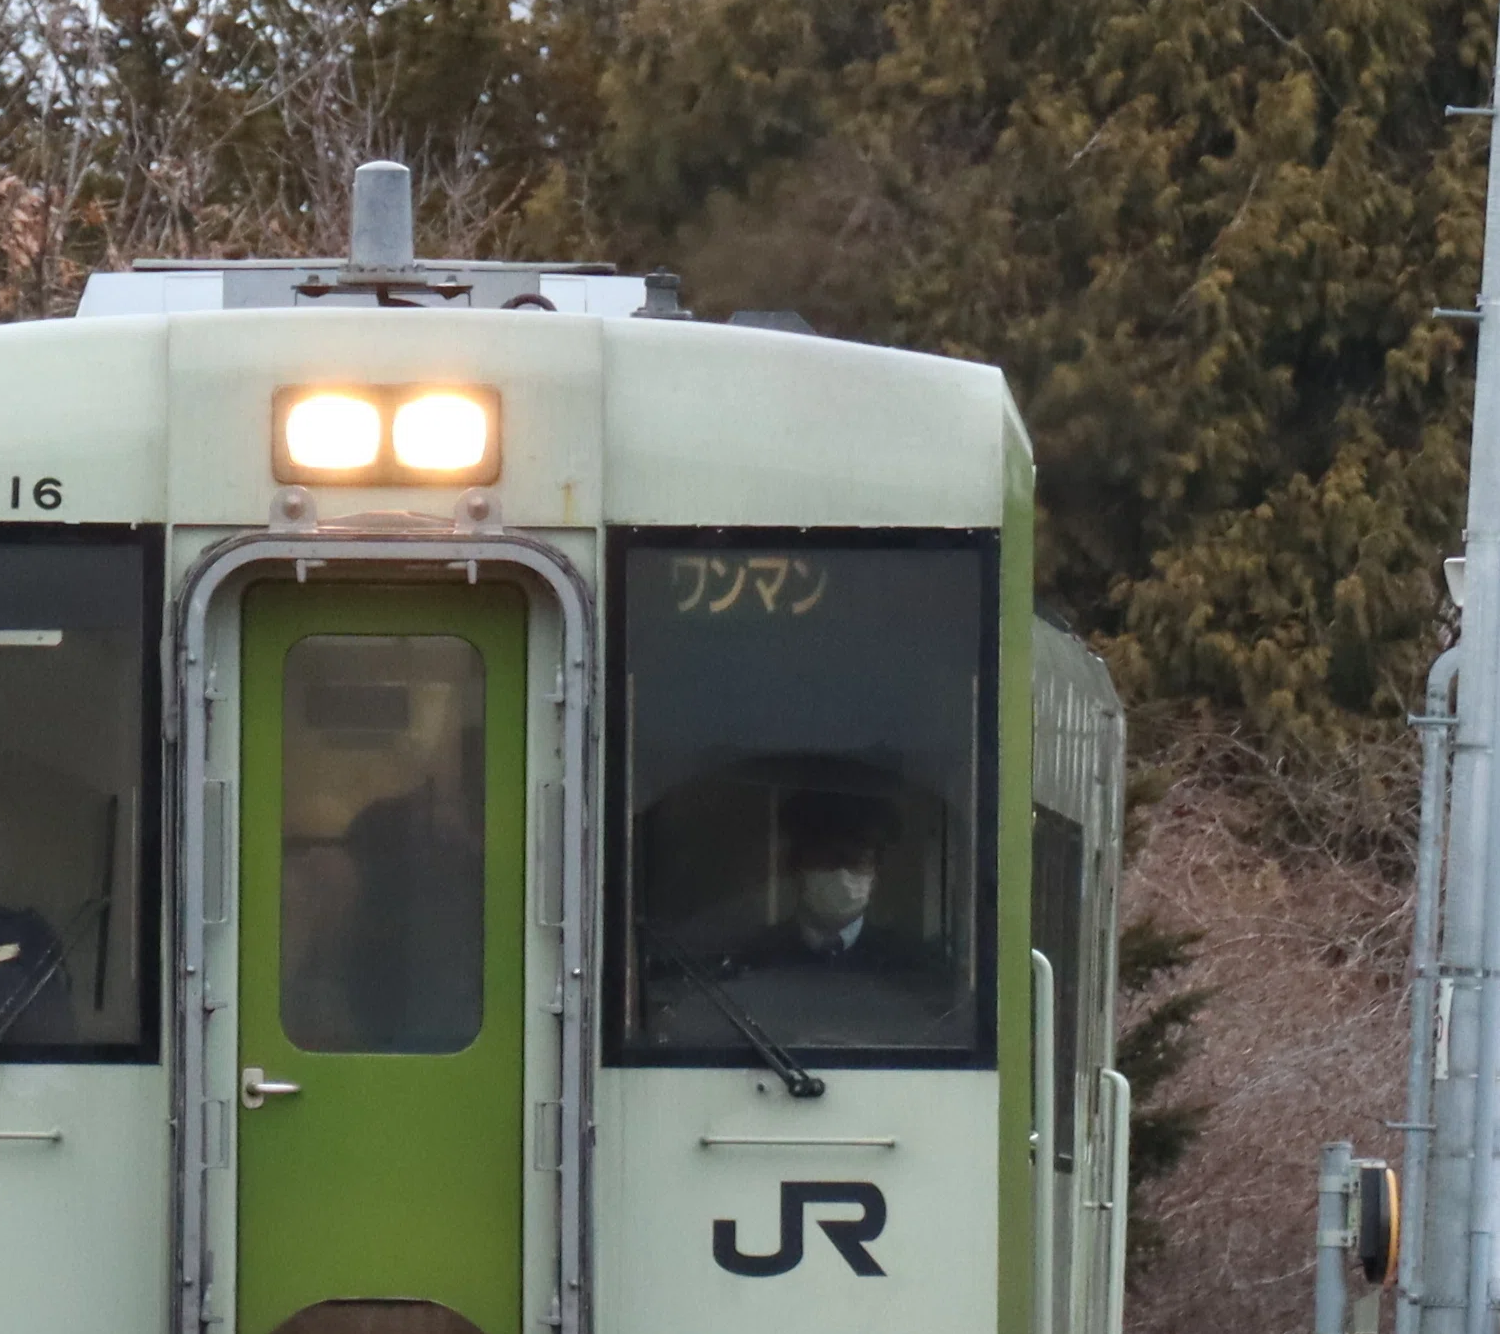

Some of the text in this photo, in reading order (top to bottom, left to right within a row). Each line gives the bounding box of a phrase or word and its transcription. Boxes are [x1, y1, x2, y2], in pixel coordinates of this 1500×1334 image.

[672, 556, 828, 614] ワンマン
[713, 1181, 887, 1277] JR
